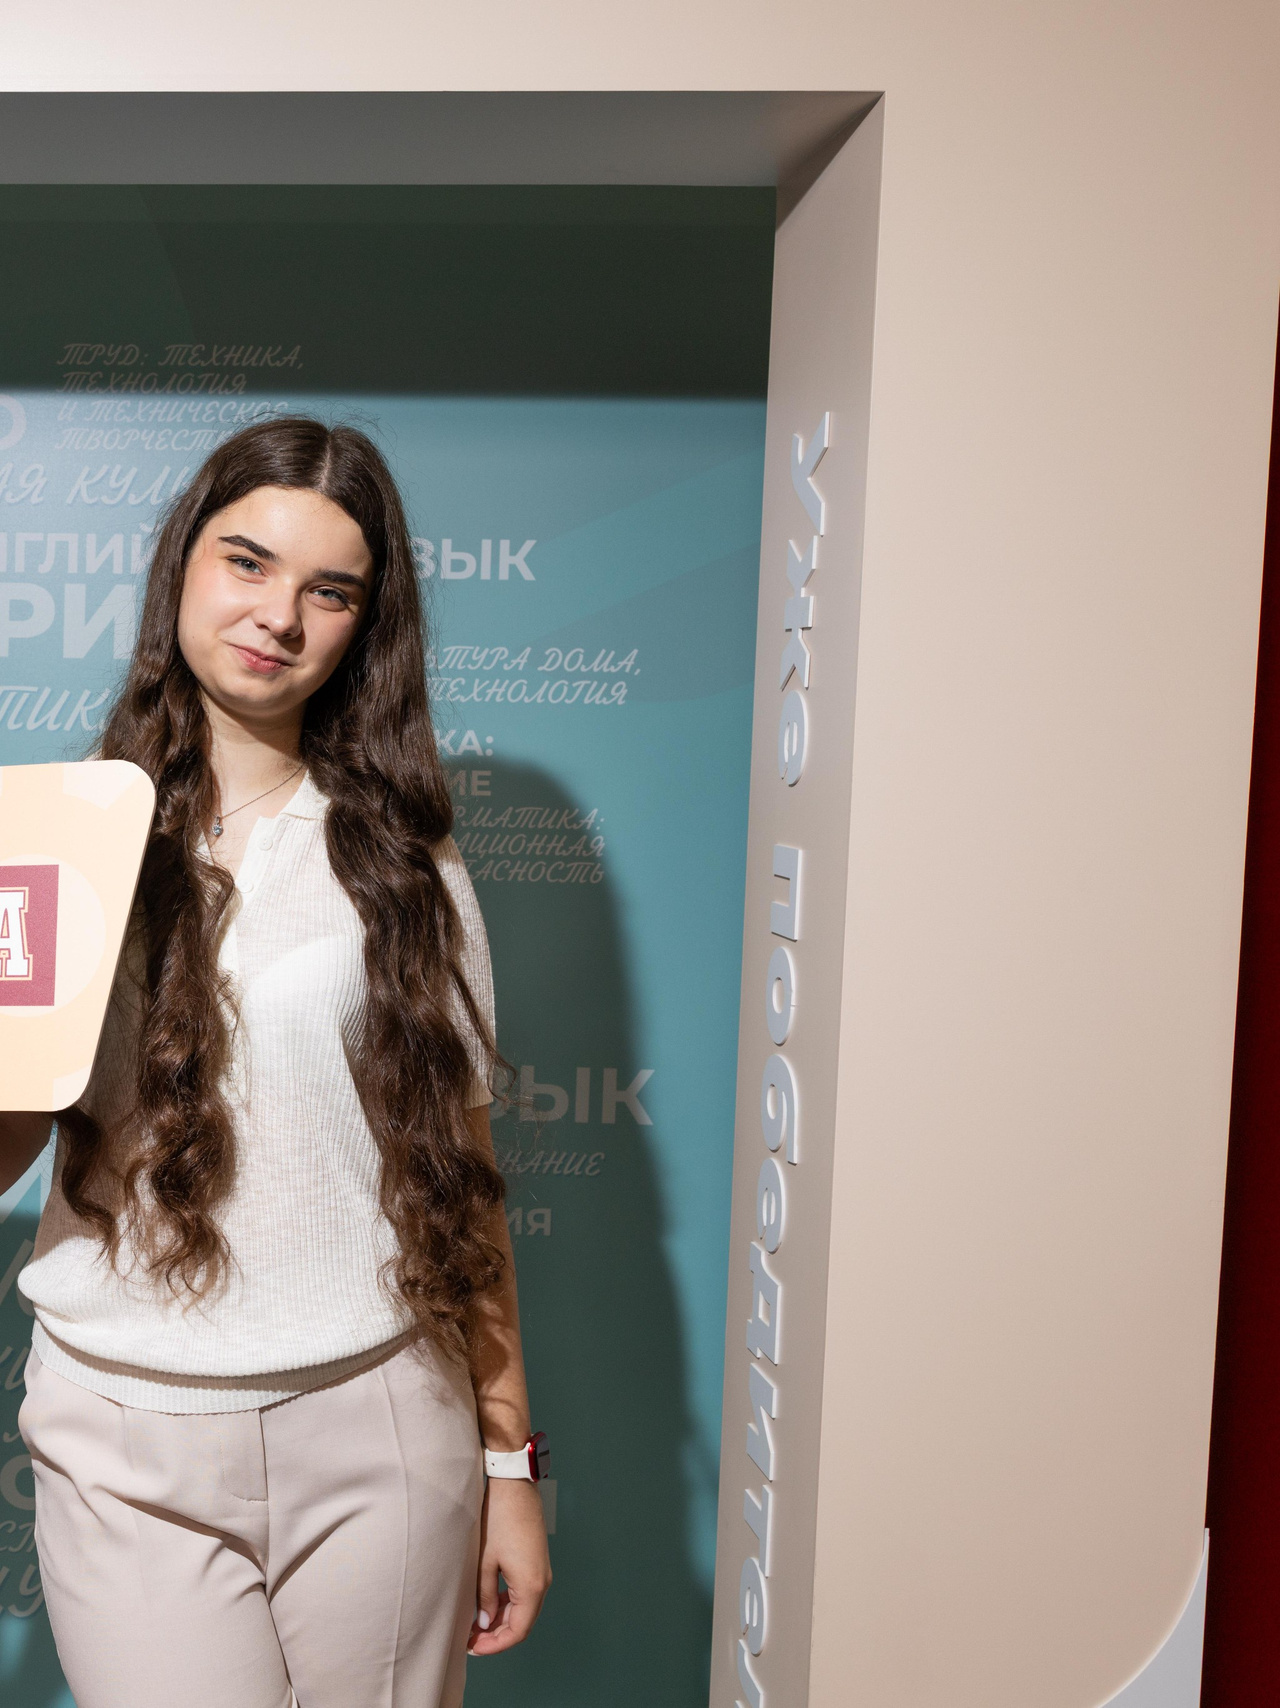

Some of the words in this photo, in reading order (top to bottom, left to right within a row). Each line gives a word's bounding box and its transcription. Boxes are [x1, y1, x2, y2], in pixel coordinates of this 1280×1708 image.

[56, 343, 149, 366] ТРУД:
[157, 344, 305, 369] ТЕХНИКА,
[55, 371, 248, 395] ТЕХНОЛОГИЯ
[57, 401, 75, 422] И
[410, 537, 538, 581] ЗЫК
[537, 647, 642, 675] ДОМА,
[454, 806, 605, 831] РМАТИКА:
[456, 832, 606, 859] АЦИОННАЯ
